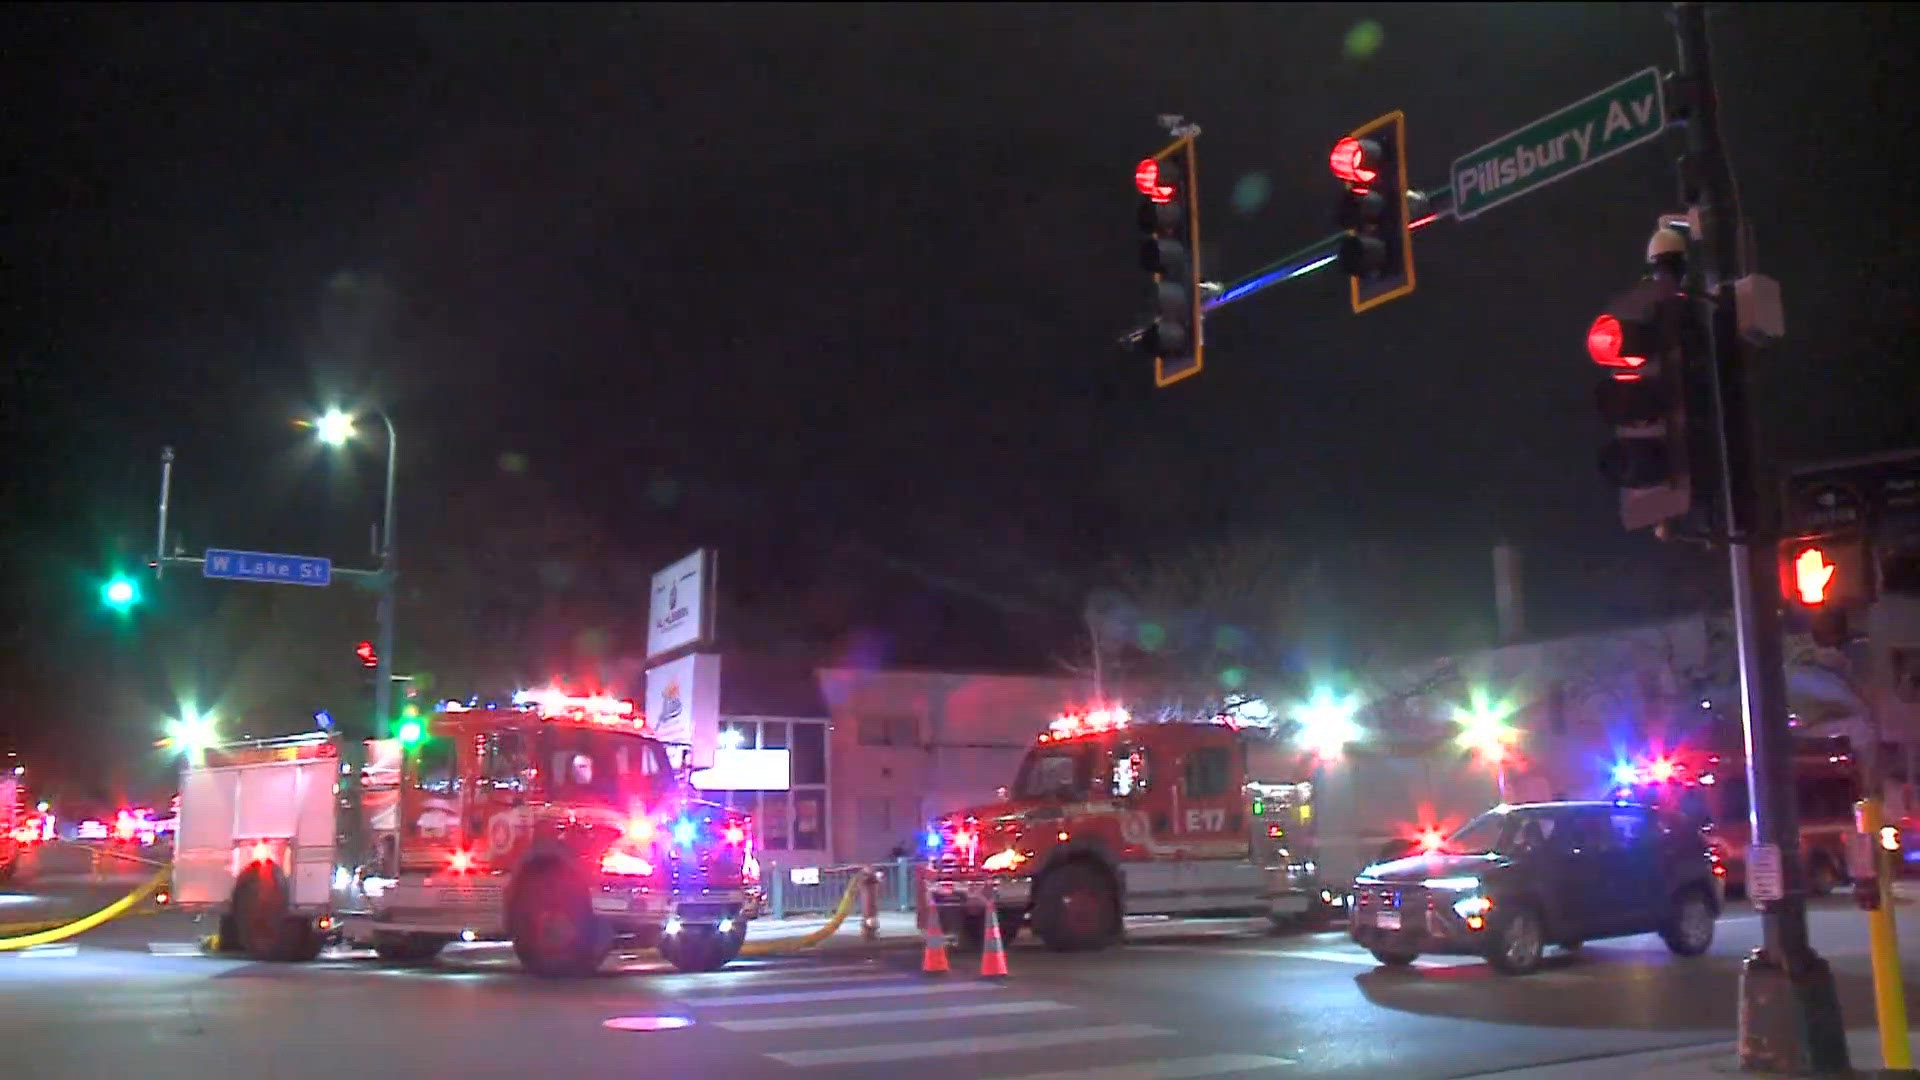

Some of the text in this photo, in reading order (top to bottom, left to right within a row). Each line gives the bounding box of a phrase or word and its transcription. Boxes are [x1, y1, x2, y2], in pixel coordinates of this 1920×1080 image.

[1457, 93, 1655, 205] Pillsbury Av
[213, 555, 323, 579] W Lake St
